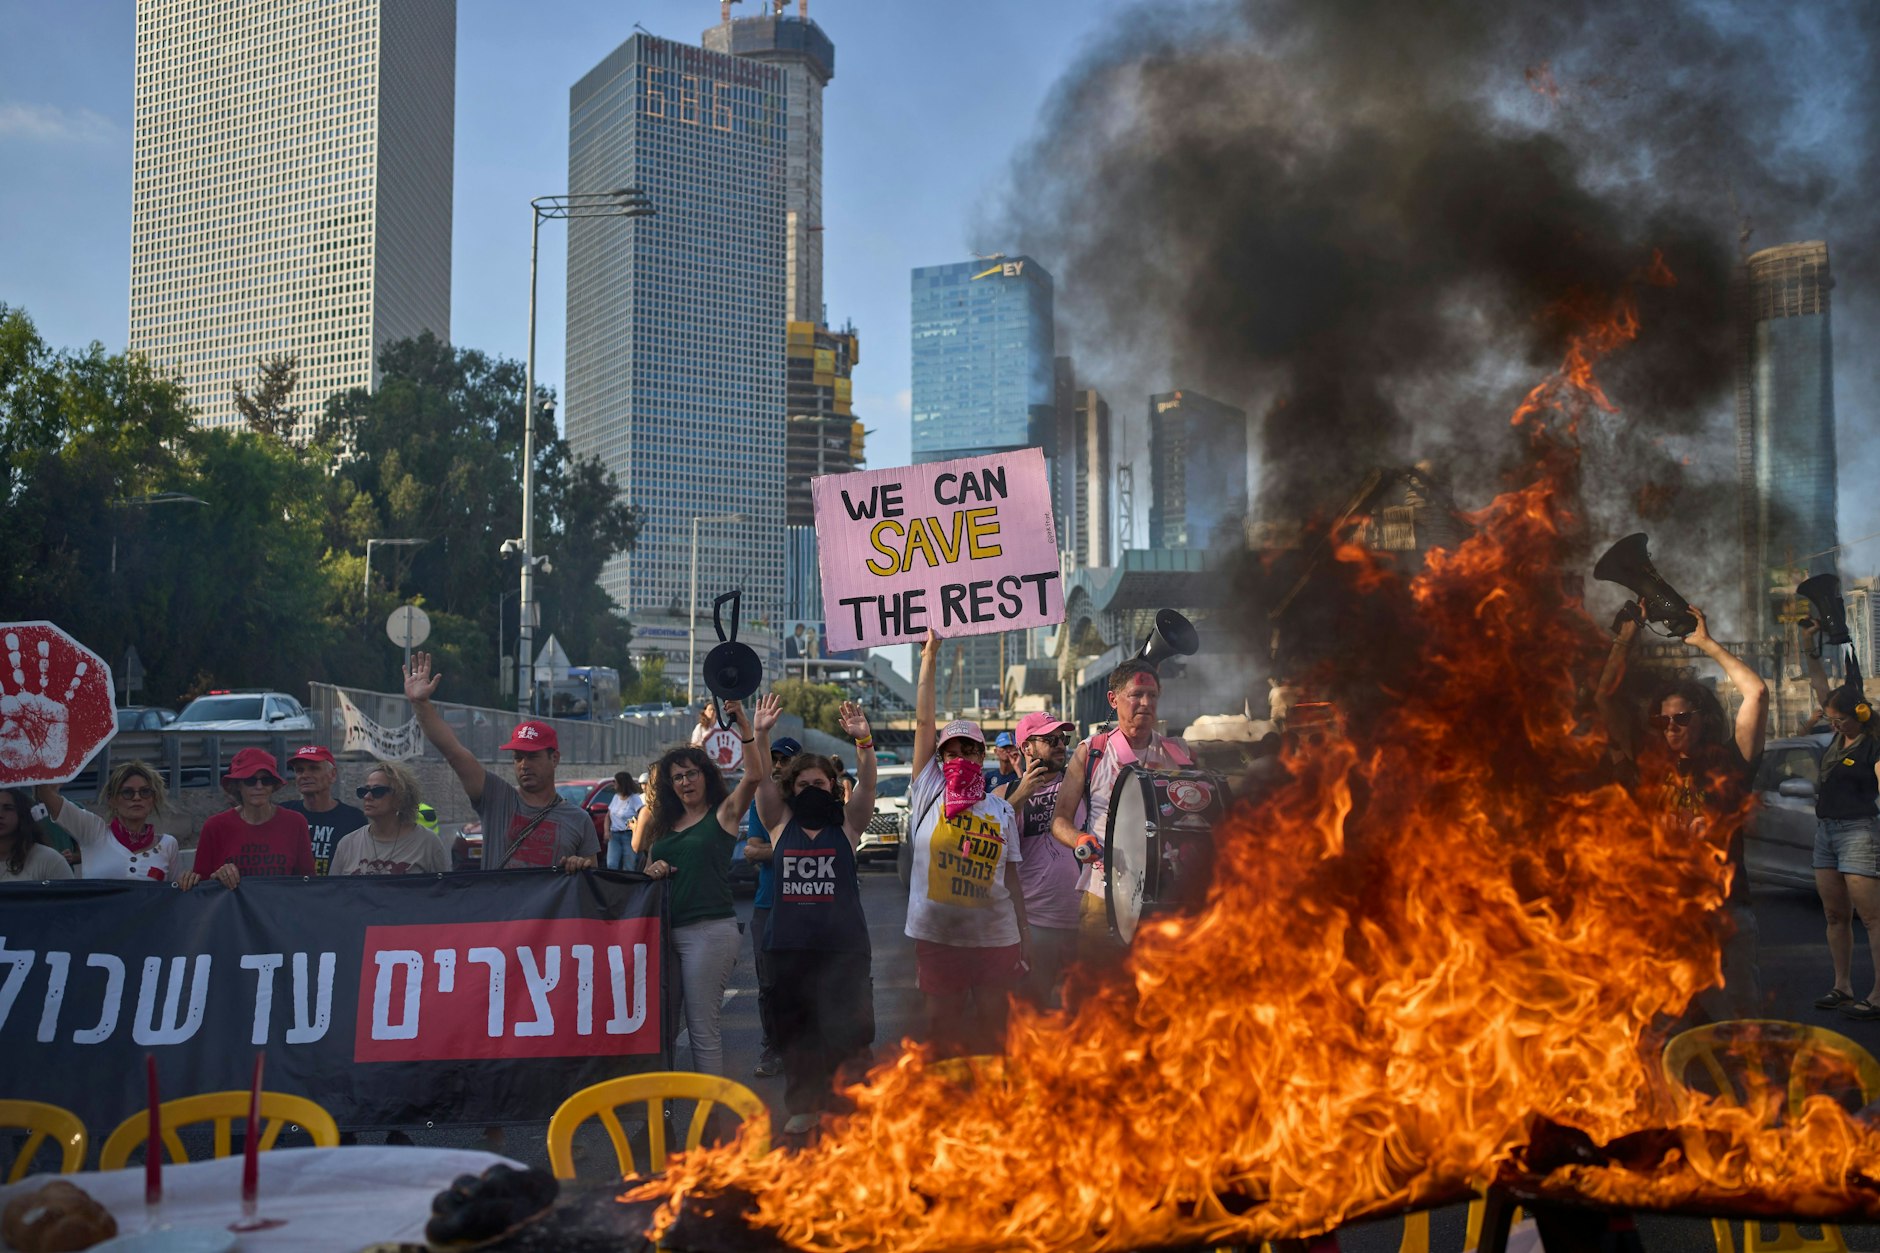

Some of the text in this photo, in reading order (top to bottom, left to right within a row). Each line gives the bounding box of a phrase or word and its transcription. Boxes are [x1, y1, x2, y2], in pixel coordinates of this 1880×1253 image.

[1003, 260, 1024, 277] EY
[841, 466, 1008, 521] WE CAN
[866, 506, 1002, 576] SAVE
[839, 571, 1059, 641] THE REST
[947, 728, 969, 737] WAR
[1028, 793, 1057, 807] VICTO
[945, 814, 973, 832] לכ
[1030, 810, 1053, 822] HOST
[312, 825, 335, 842] MY
[783, 856, 836, 879] FCK
[938, 851, 992, 880] להקריב
[782, 882, 835, 895] BNGVR
[240, 951, 337, 1045] עד
[371, 943, 647, 1041] עוצרים
